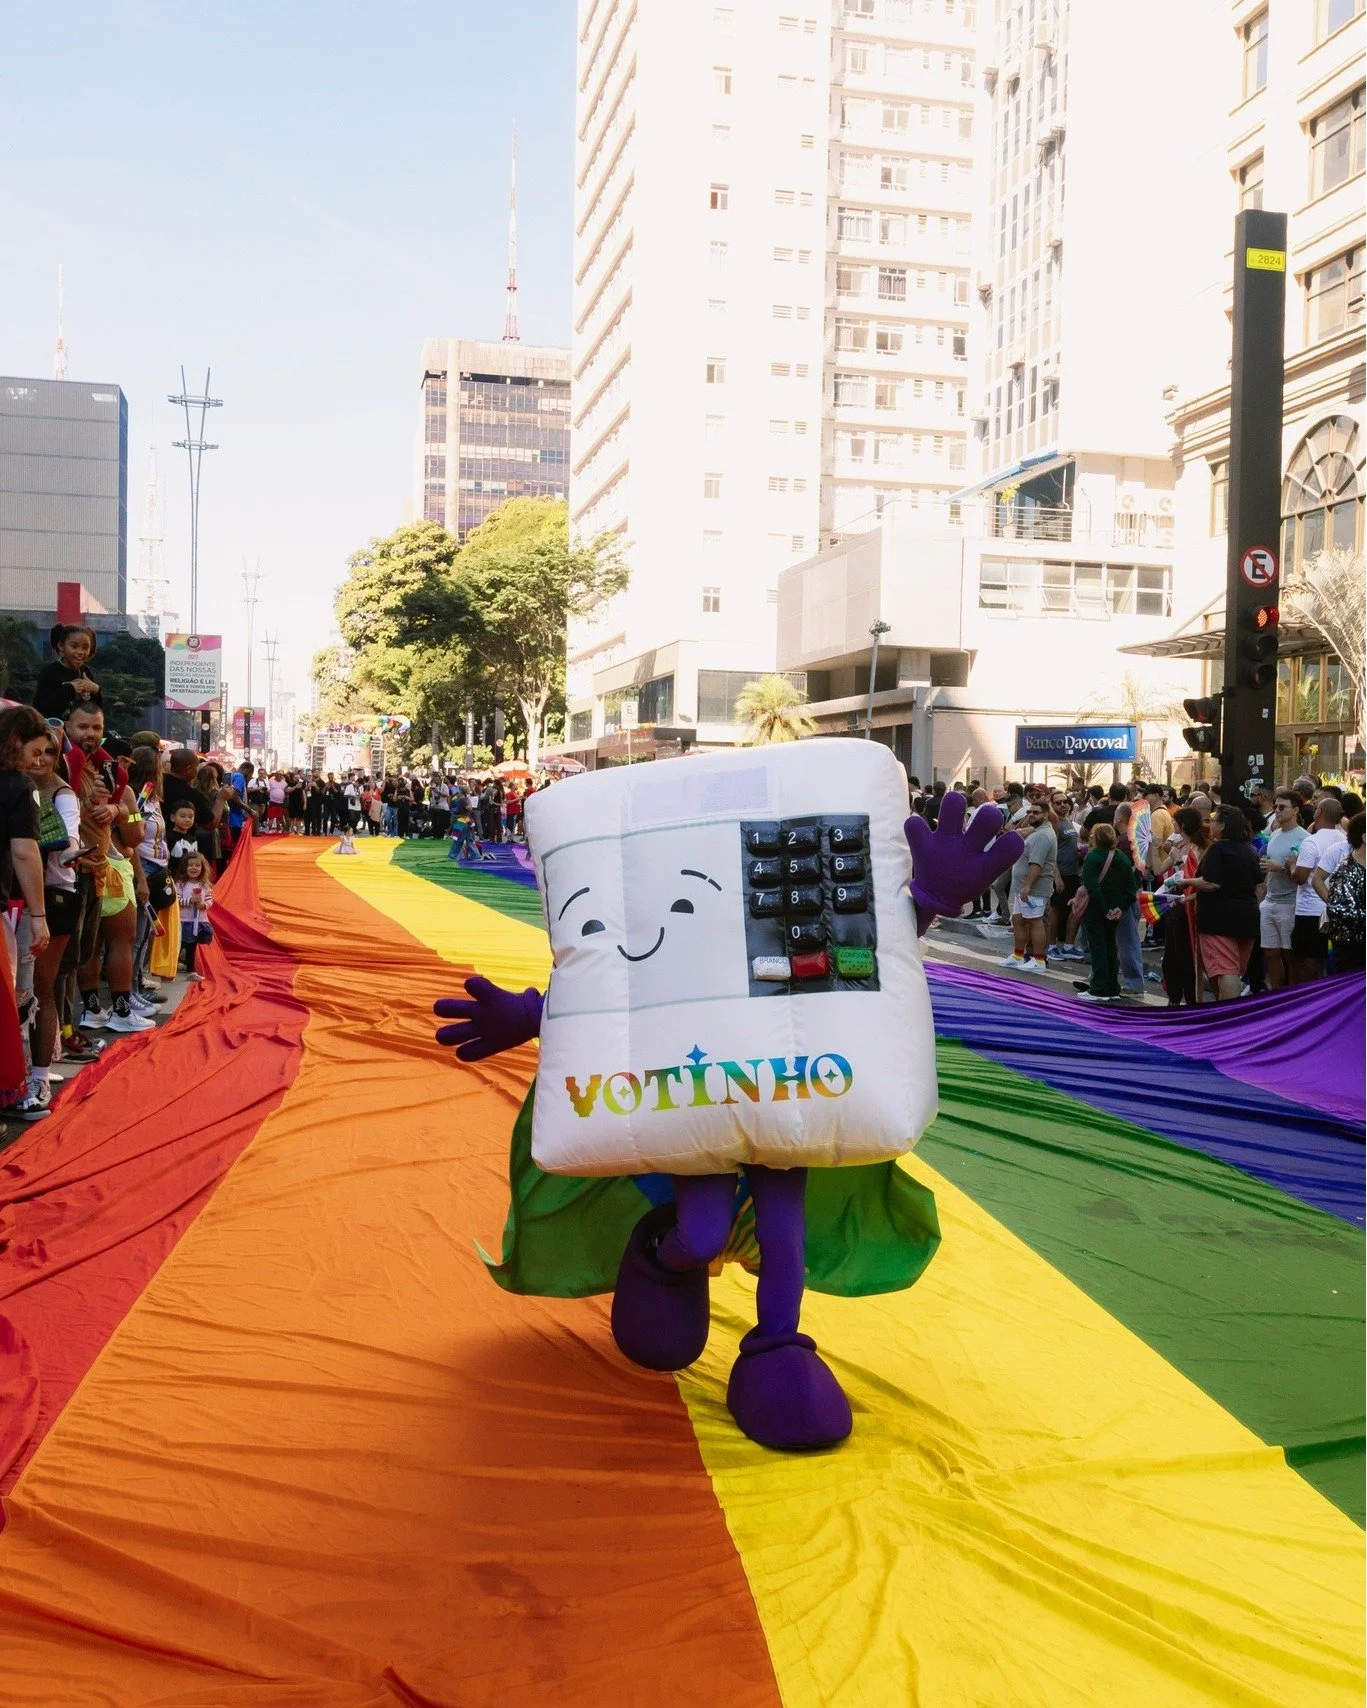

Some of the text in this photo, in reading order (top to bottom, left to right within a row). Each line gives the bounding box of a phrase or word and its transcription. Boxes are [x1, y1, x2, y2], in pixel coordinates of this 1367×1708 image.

[1257, 255, 1281, 265] 2824
[1252, 553, 1267, 579] E
[753, 829, 843, 845] 1 2 3
[754, 858, 844, 874] 4 5 6
[755, 887, 847, 905] 7 8 9
[791, 925, 800, 939] 0
[759, 956, 788, 965] BRANCO
